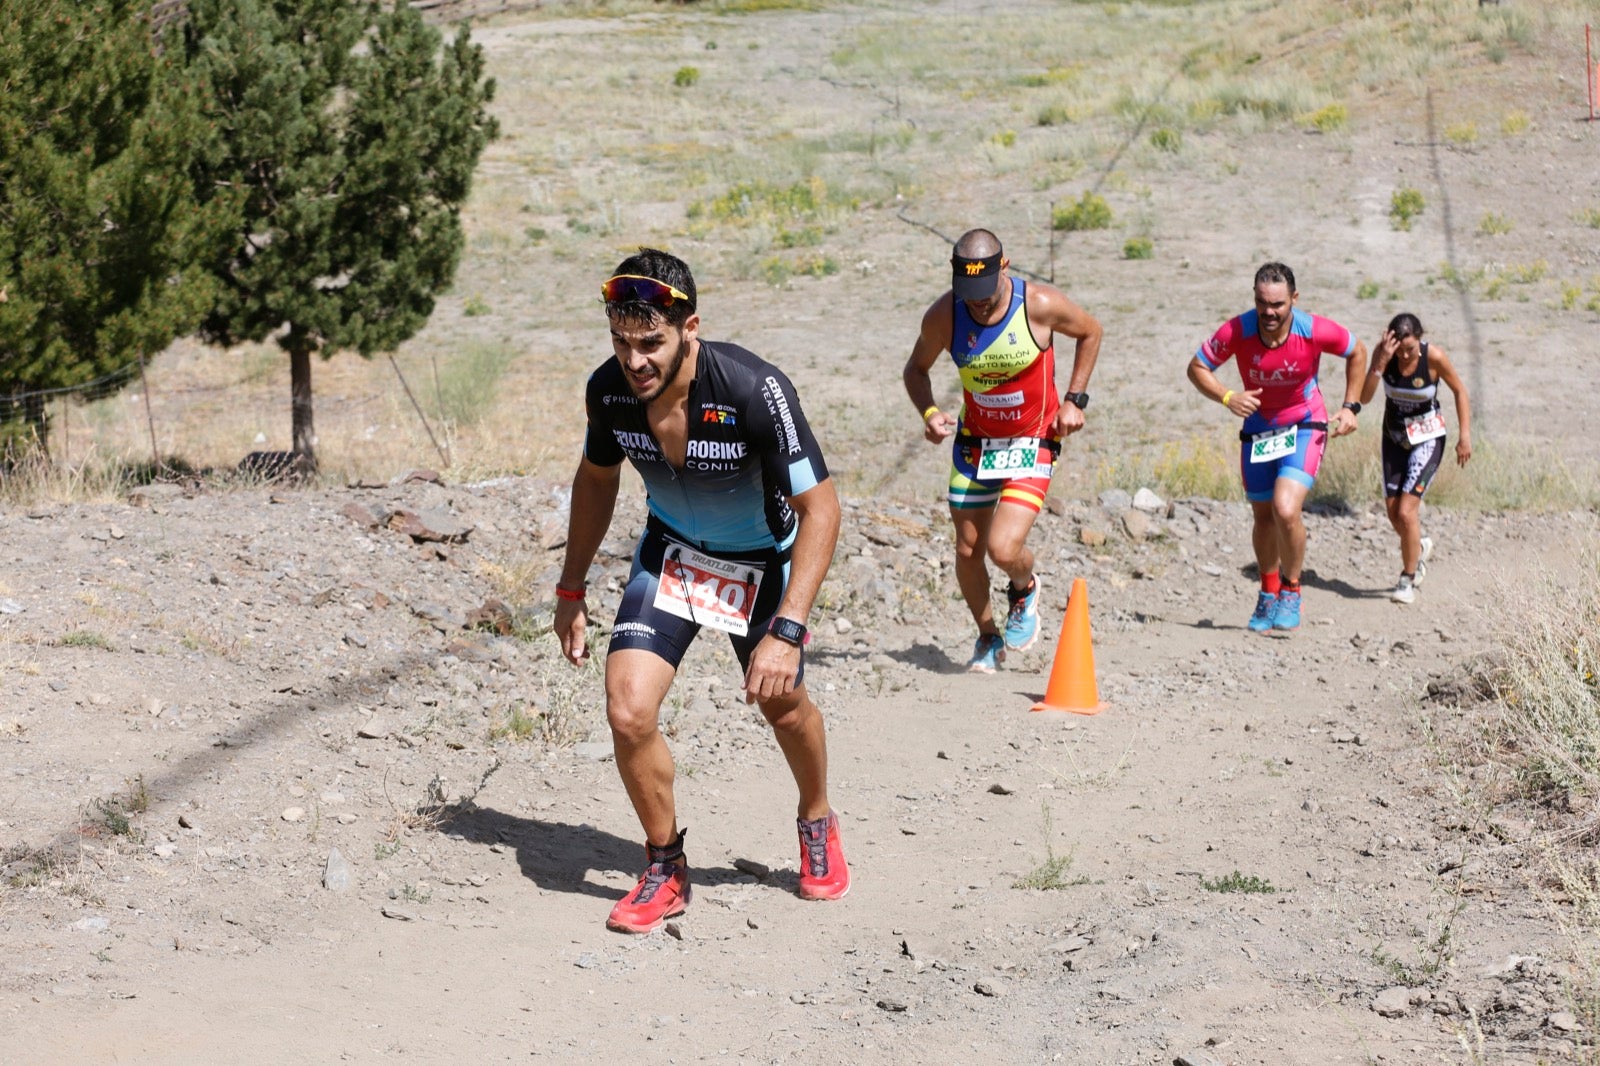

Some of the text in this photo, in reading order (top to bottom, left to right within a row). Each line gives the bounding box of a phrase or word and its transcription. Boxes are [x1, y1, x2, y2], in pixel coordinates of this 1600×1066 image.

[984, 349, 1030, 361] TRIATLÓN
[1249, 368, 1284, 381] ELA
[761, 384, 777, 416] TEAM
[774, 423, 786, 454] CONIL
[765, 375, 802, 456] CENTAUROBIKE
[686, 460, 740, 471] CONIL
[993, 449, 1023, 469] 88
[669, 566, 746, 614] 340
[624, 630, 651, 640] CONIL
